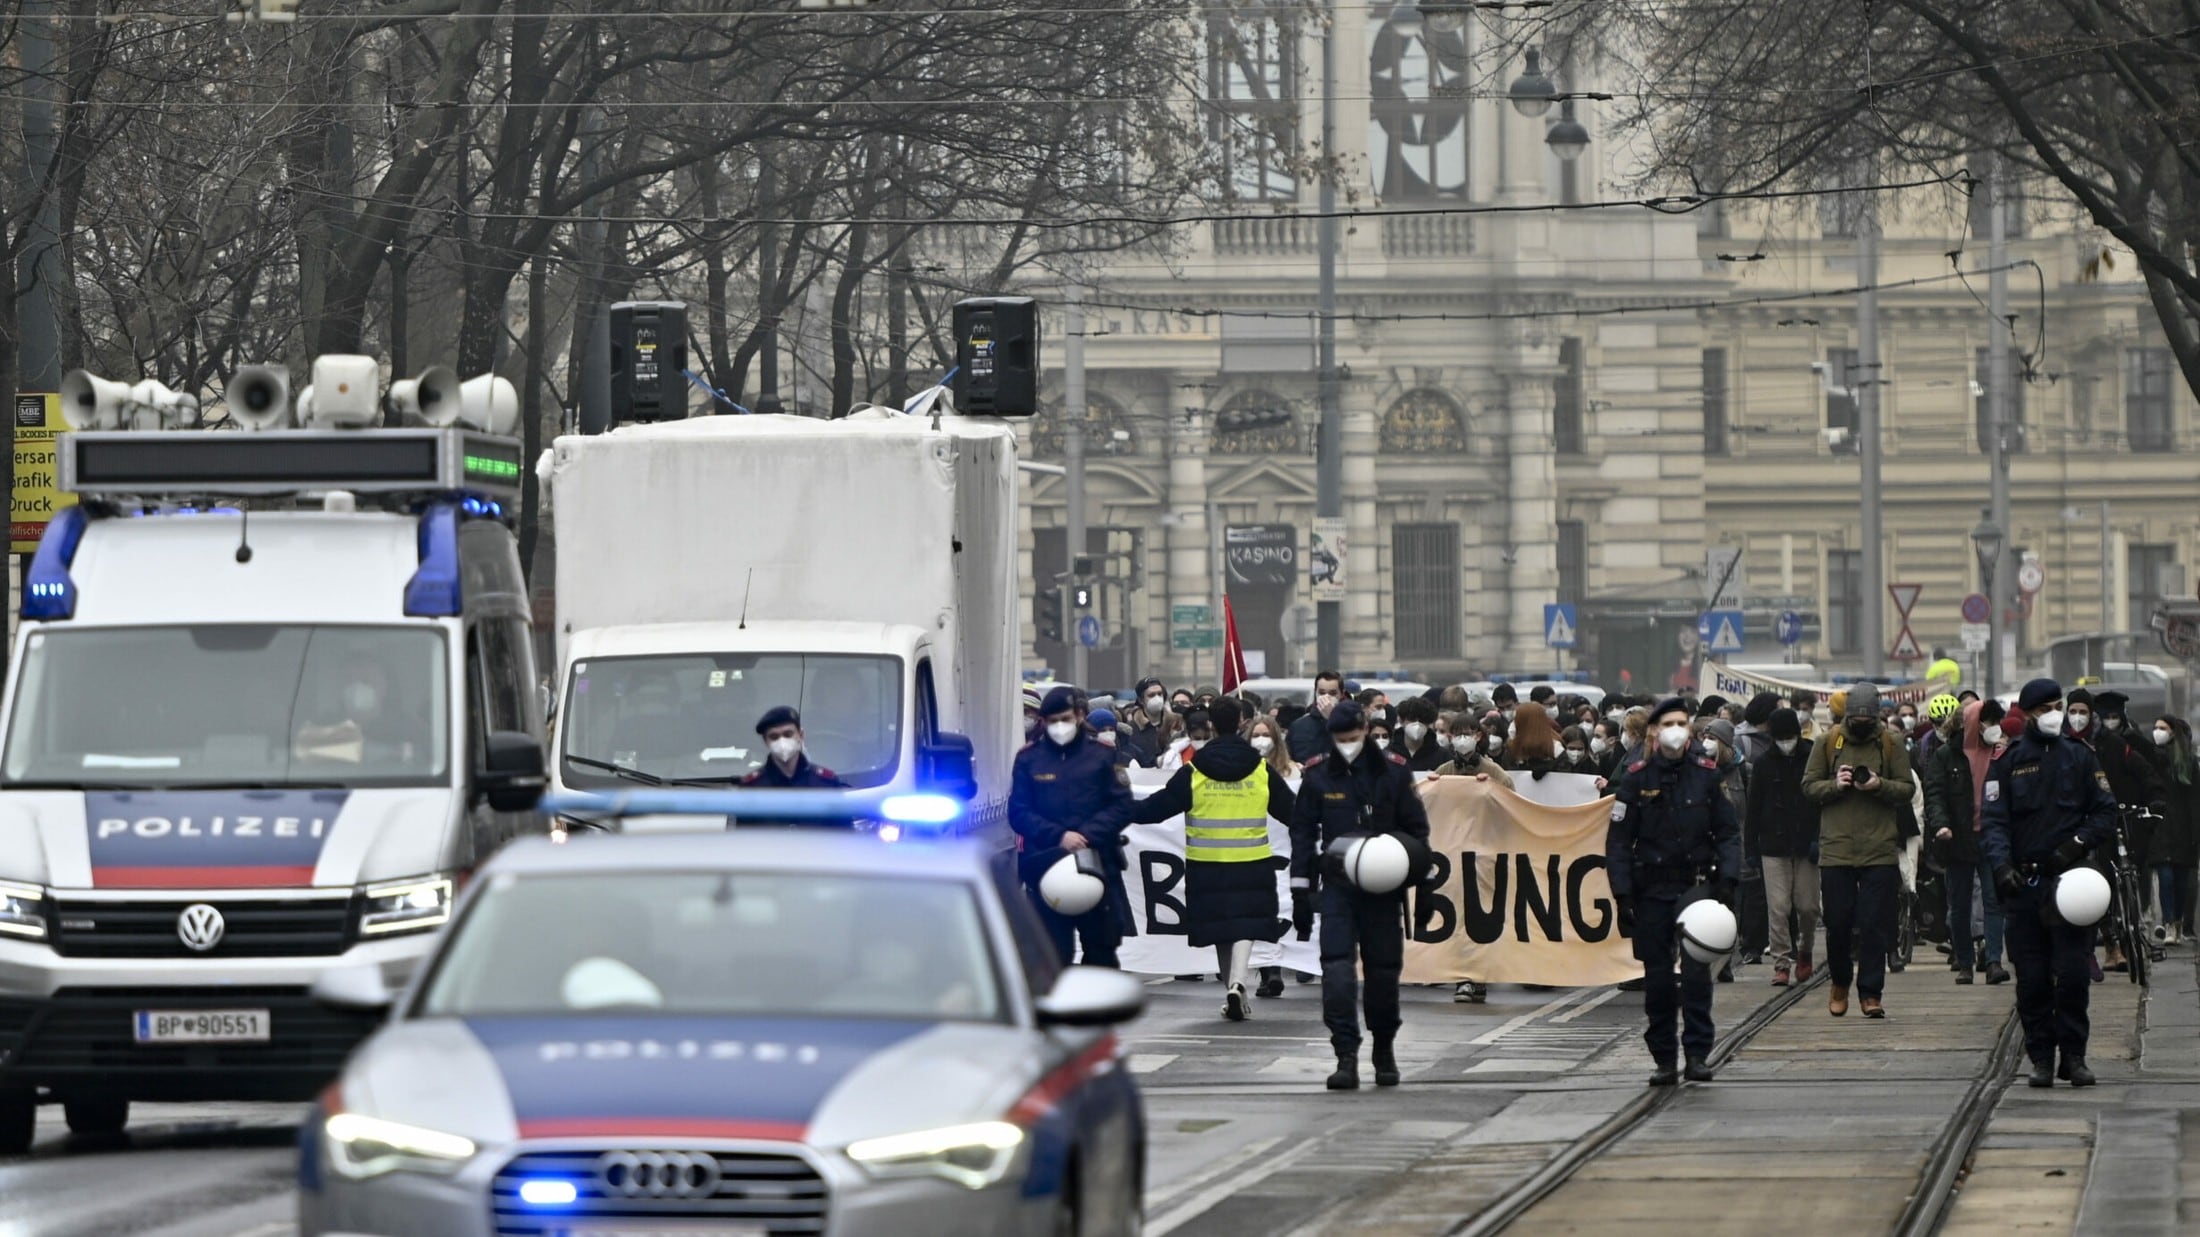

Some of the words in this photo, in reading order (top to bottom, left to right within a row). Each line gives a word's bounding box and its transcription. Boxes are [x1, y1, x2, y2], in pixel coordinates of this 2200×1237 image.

[20, 407, 40, 416] MBE
[24, 430, 47, 439] BOXES
[14, 450, 57, 465] ersan
[1231, 546, 1293, 564] KASINO
[97, 816, 324, 839] POLIZEI
